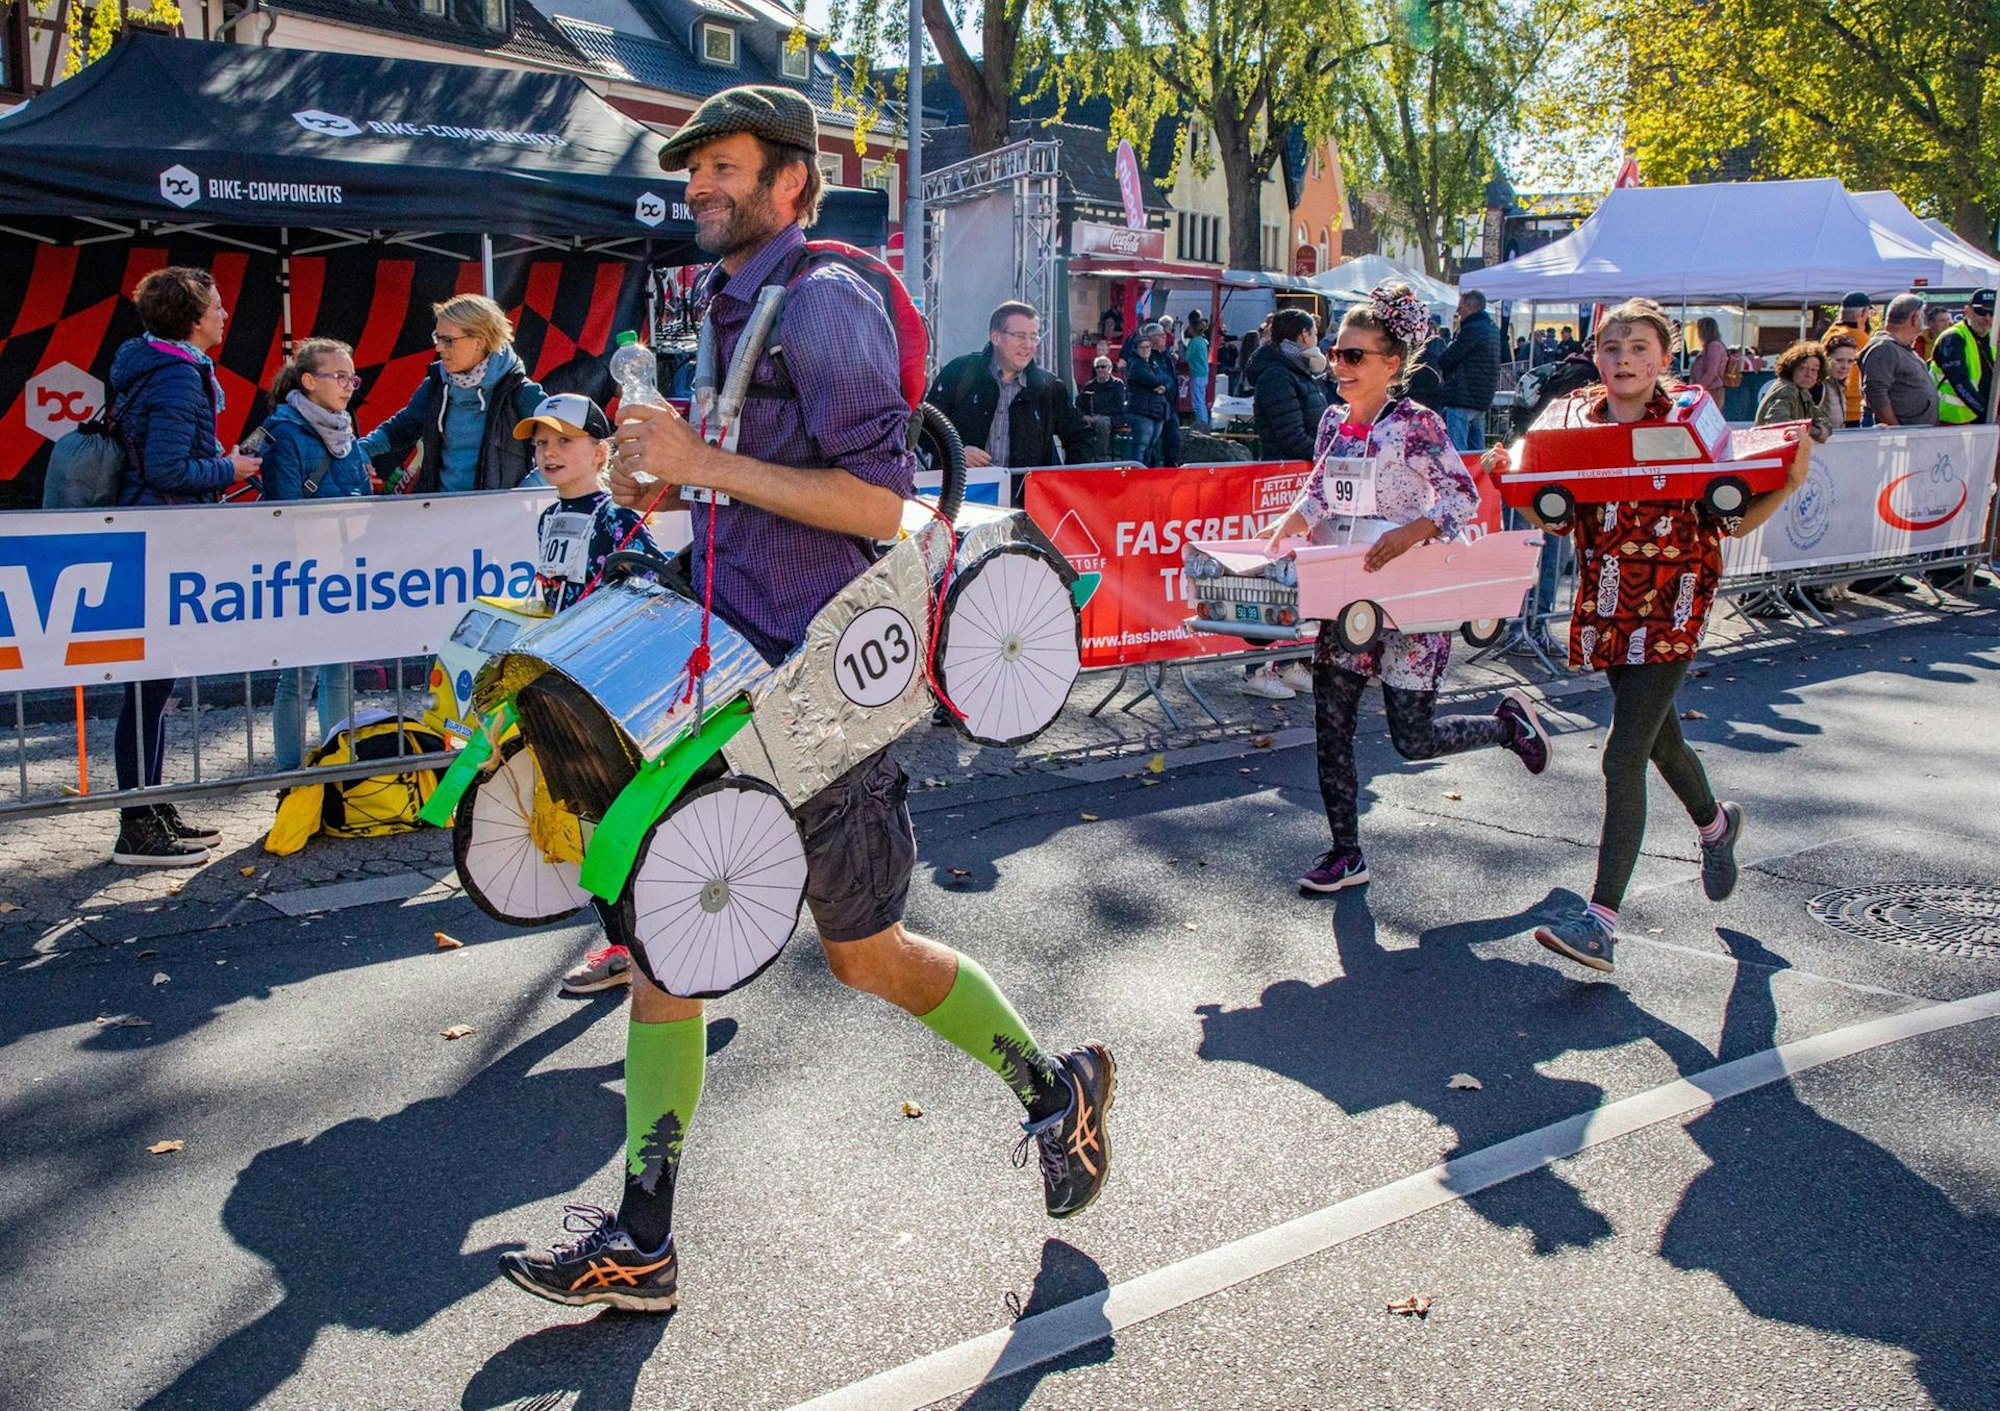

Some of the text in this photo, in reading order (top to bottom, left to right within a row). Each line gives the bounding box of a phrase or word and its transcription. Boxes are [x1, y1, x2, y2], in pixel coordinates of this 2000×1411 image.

[366, 120, 568, 147] BIKE-COMPONENTS
[208, 178, 343, 204] BIKE-COMPONENTS
[672, 203, 695, 220] BIK
[1260, 478, 1294, 493] JETZT
[1260, 489, 1300, 508] AHRW
[1335, 480, 1353, 502] 99
[1116, 513, 1282, 557] FASSBEN
[542, 538, 569, 564] 01
[1069, 558, 1107, 571] TOFF
[168, 549, 537, 626] Raiffeisenba
[843, 623, 910, 691] 103
